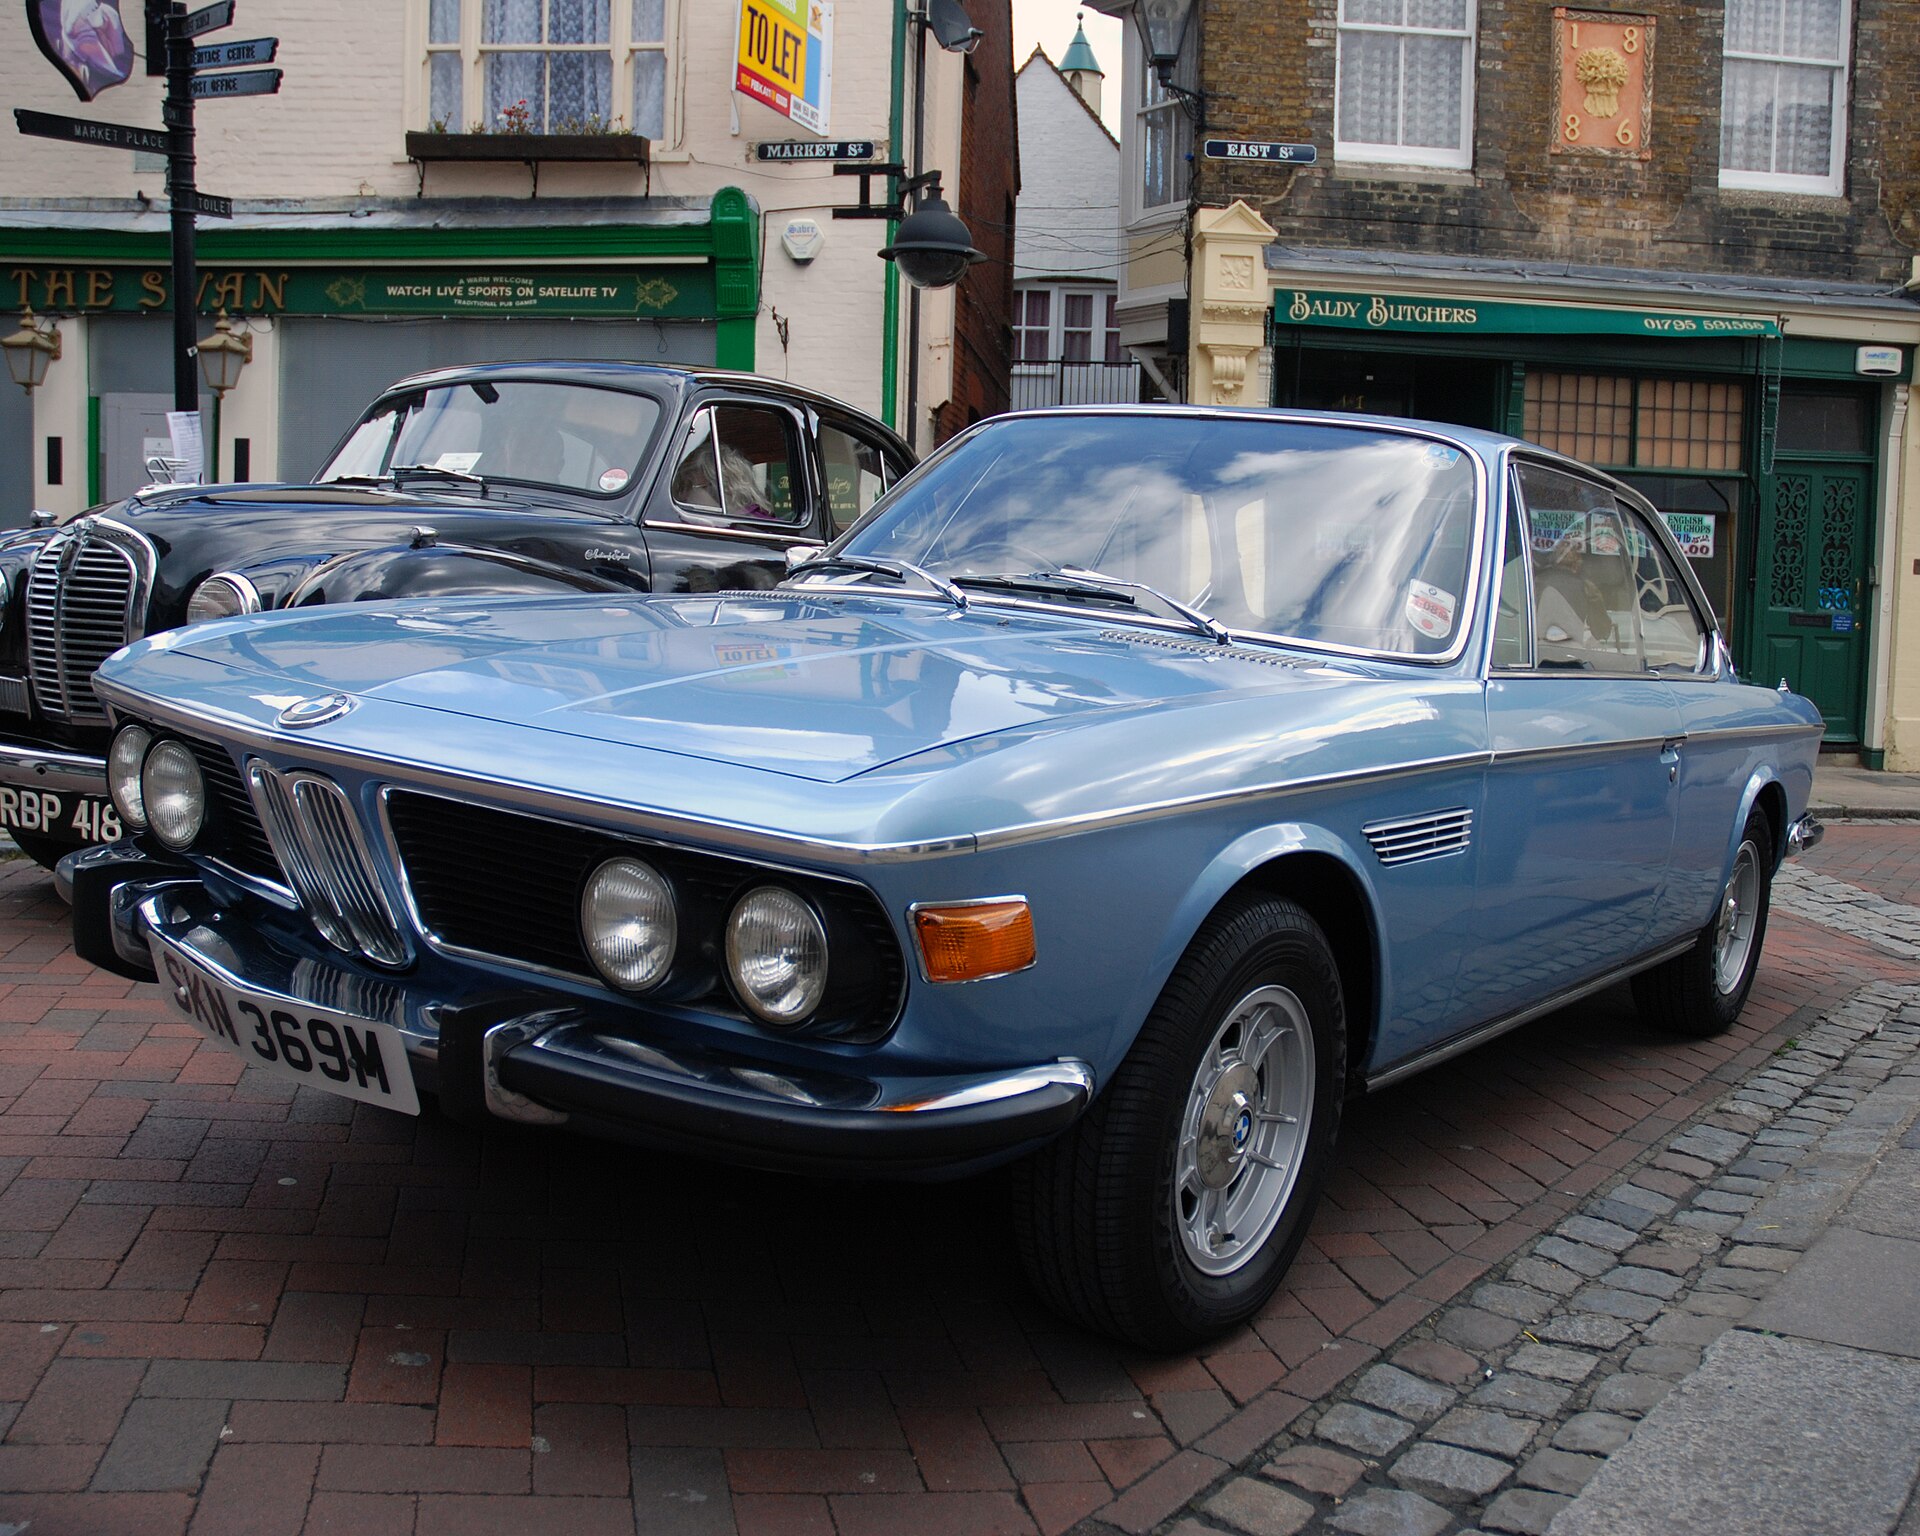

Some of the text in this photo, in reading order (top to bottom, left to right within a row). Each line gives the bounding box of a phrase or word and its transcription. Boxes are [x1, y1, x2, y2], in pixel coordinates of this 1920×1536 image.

[747, 5, 802, 84] TO LET
[1570, 24, 1639, 54] 1 8
[226, 45, 256, 60] CENTRE
[210, 78, 238, 93] OFFICE
[74, 124, 165, 149] MARKET PLACE
[1564, 113, 1633, 145] 8 6
[766, 143, 838, 158] MARKET
[1226, 143, 1270, 159] EAST
[11, 270, 115, 307] THE
[492, 276, 534, 286] WELCOME
[386, 286, 618, 297] WATCH LIVE SPORTS ON SATELLITE TV
[453, 299, 497, 307] TRADITIONAL
[1643, 318, 1697, 331] 01795
[1538, 512, 1576, 521] ENGLISH
[1667, 515, 1703, 525] ENGLISH
[0, 786, 122, 842] RBP 418
[237, 1000, 392, 1095] 369M
